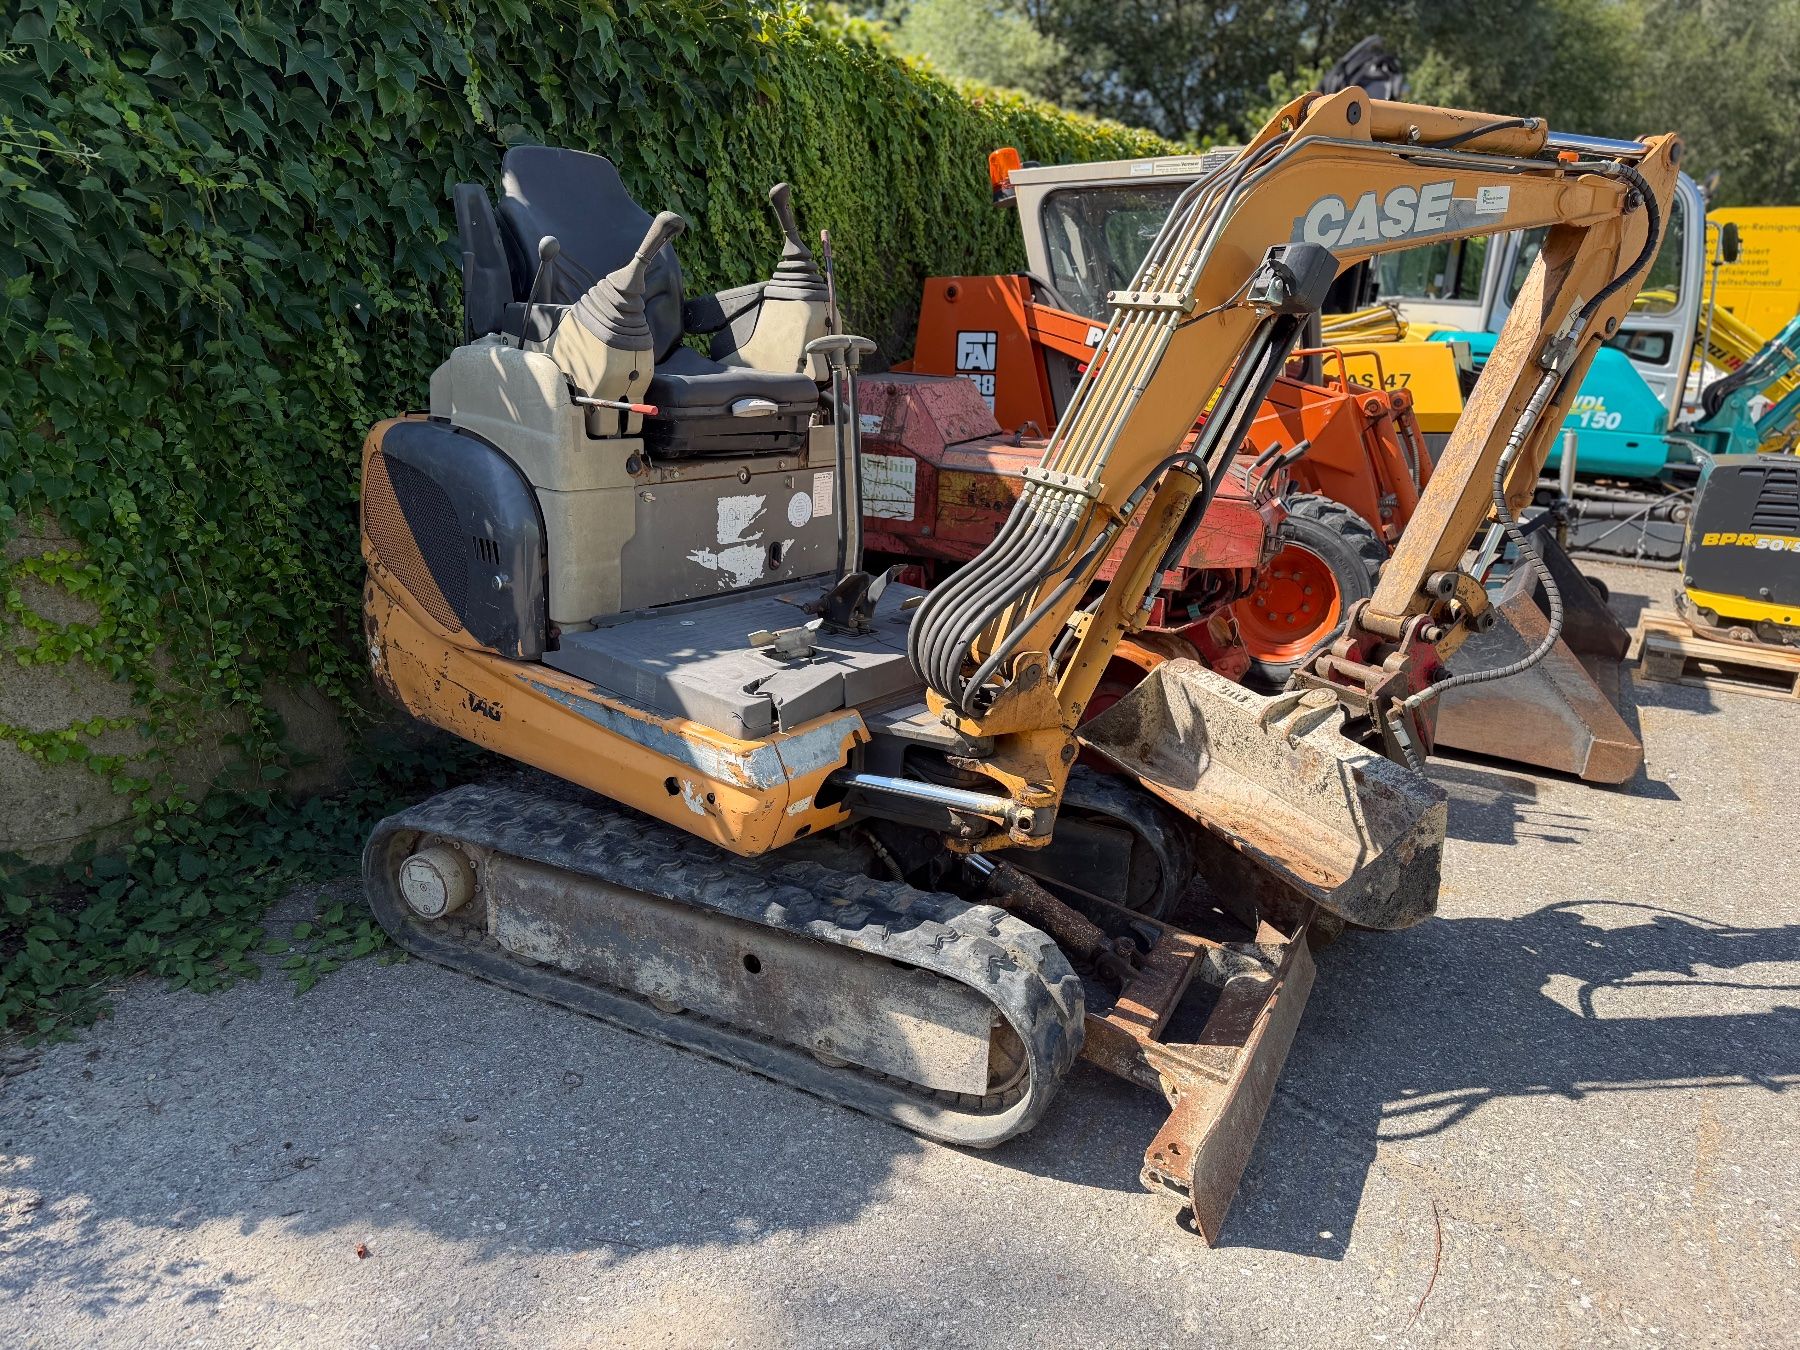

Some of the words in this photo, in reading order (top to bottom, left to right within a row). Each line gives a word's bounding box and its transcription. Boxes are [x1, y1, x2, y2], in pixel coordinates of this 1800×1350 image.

[1303, 181, 1456, 249] CASE
[1384, 373, 1412, 388] 47
[1580, 411, 1622, 430] 150
